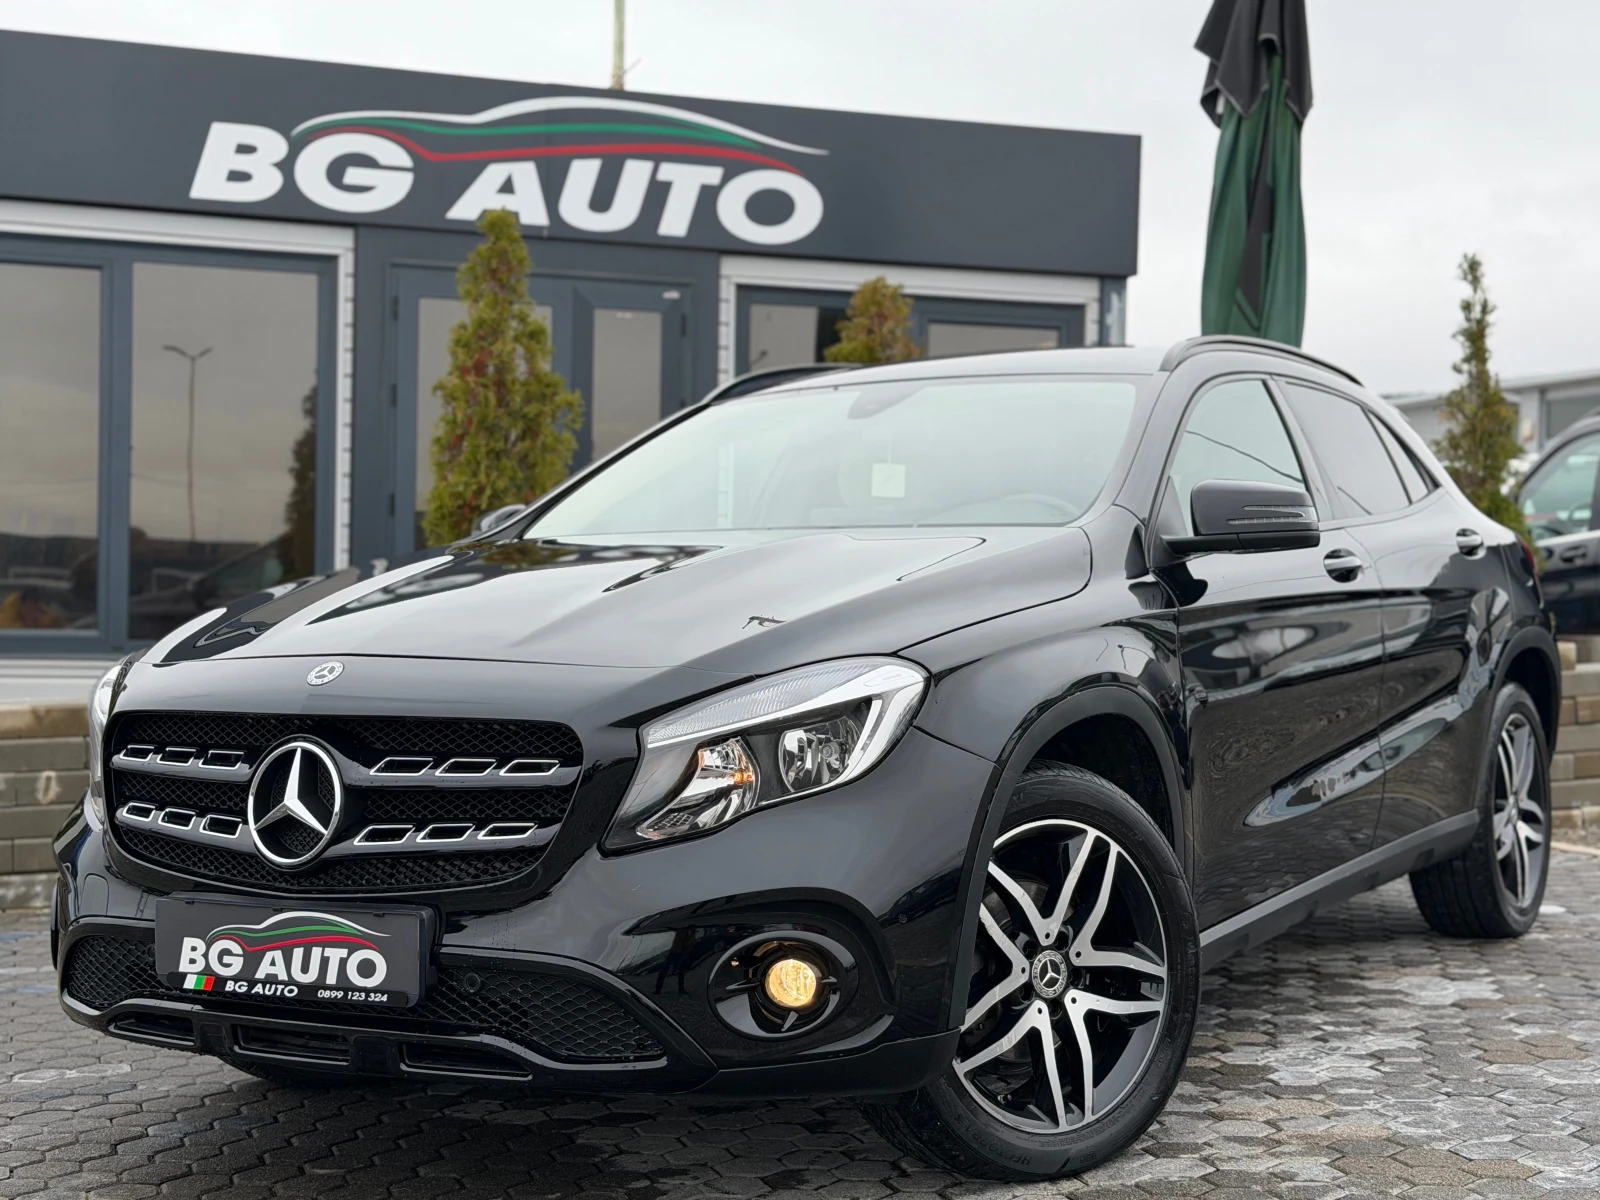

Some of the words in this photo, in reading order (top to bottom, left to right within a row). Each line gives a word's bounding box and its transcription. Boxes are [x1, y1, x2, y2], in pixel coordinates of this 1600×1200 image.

[189, 121, 415, 213] BG
[445, 157, 824, 246] AUTO
[178, 937, 244, 976] BG
[254, 946, 387, 988] AUTO
[225, 980, 248, 993] BG
[251, 983, 298, 997] AUTO
[317, 989, 344, 999] 0899
[347, 991, 365, 1001] 123
[367, 992, 388, 1002] 324
